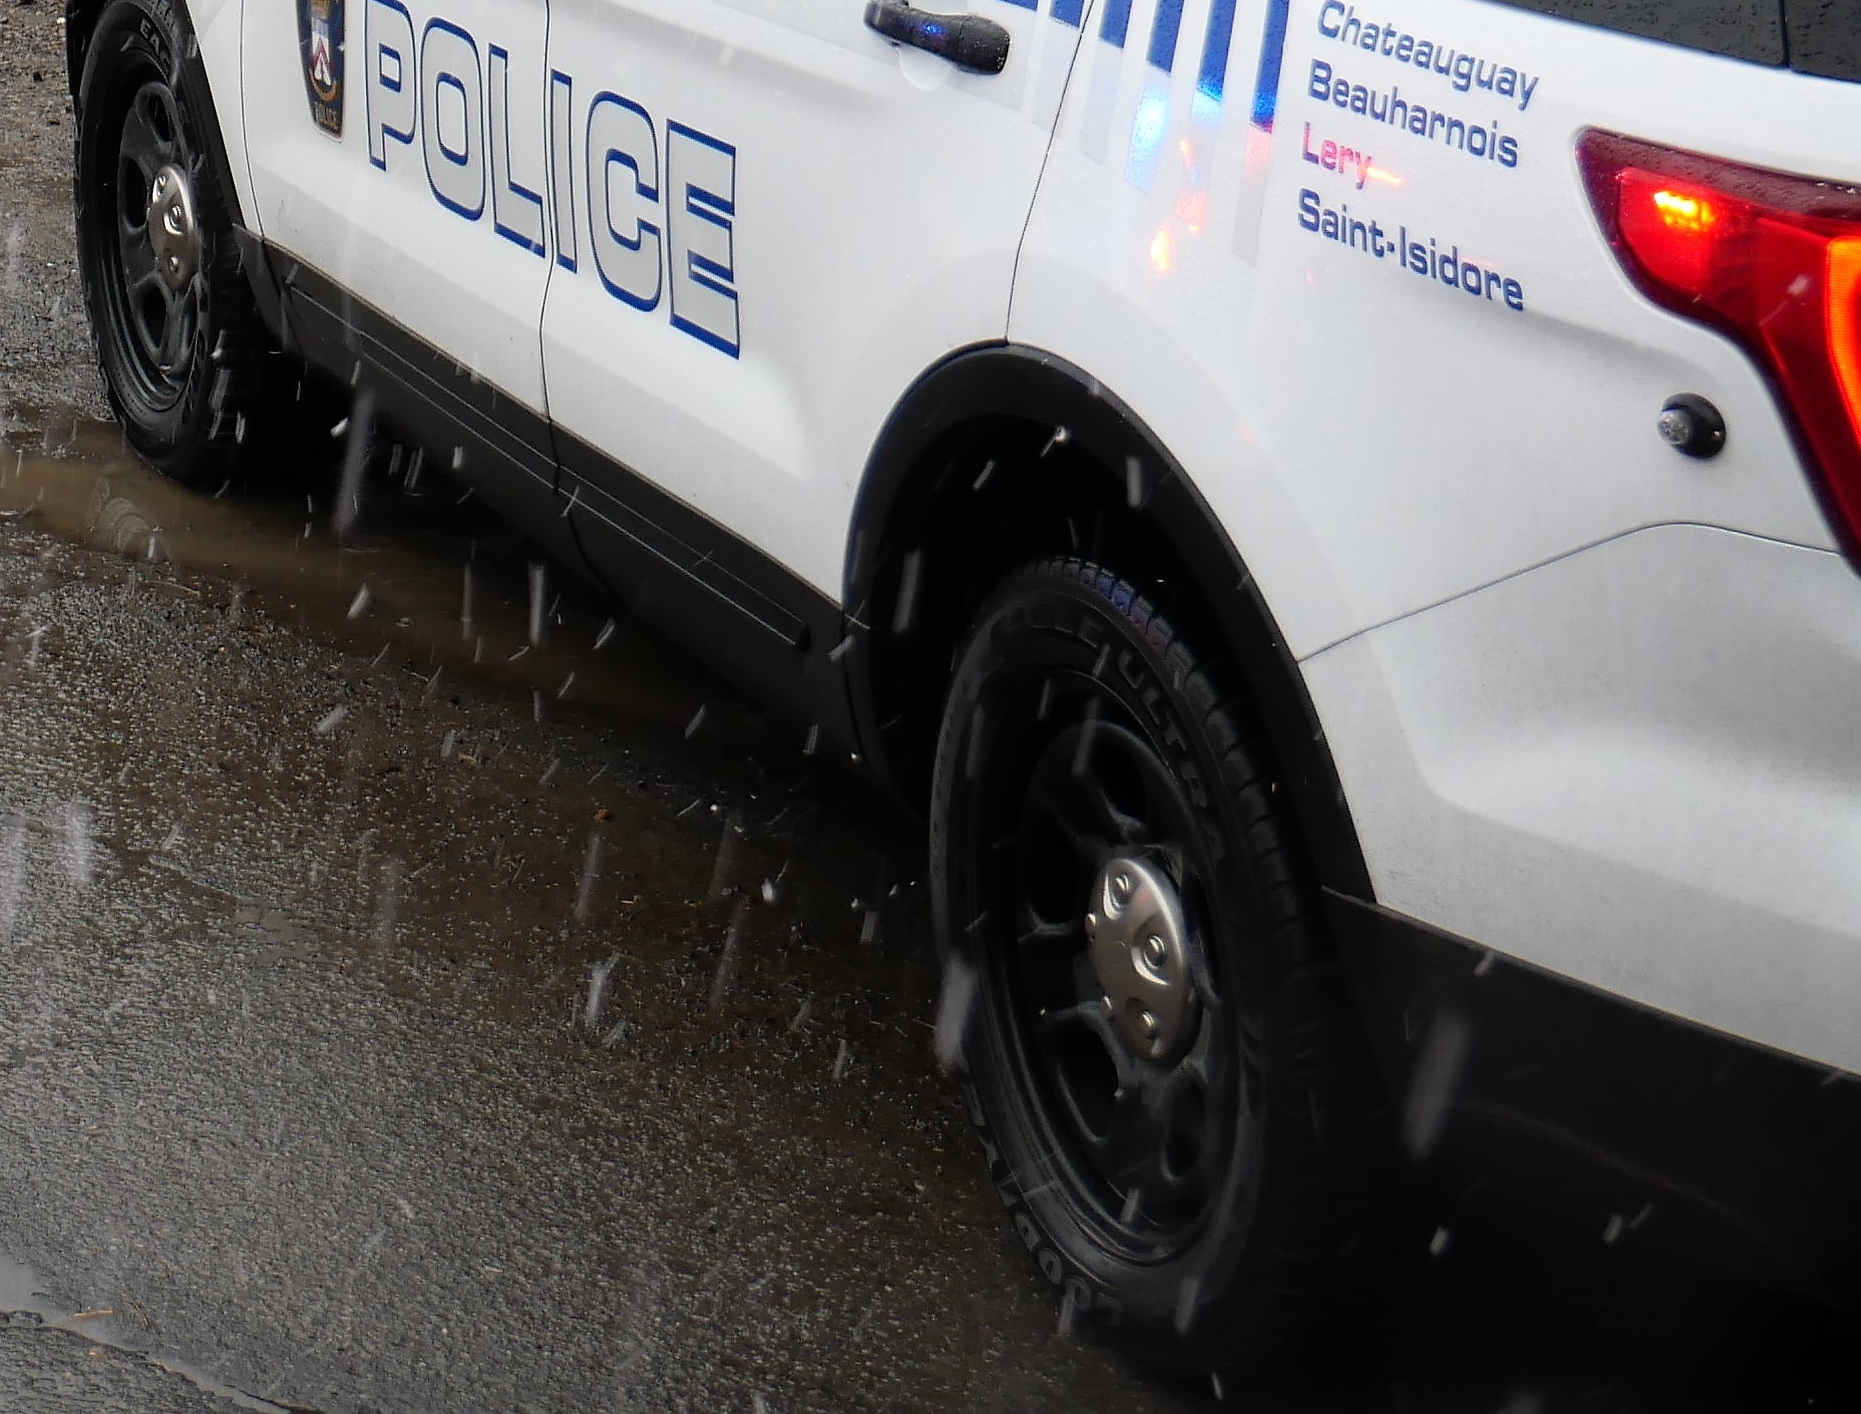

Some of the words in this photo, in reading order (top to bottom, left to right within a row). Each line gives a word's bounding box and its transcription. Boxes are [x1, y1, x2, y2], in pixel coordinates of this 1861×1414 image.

[1302, 121, 1372, 190] Lery
[1307, 57, 1519, 169] Beauharnois
[1298, 187, 1524, 312] Saint-Isidore
